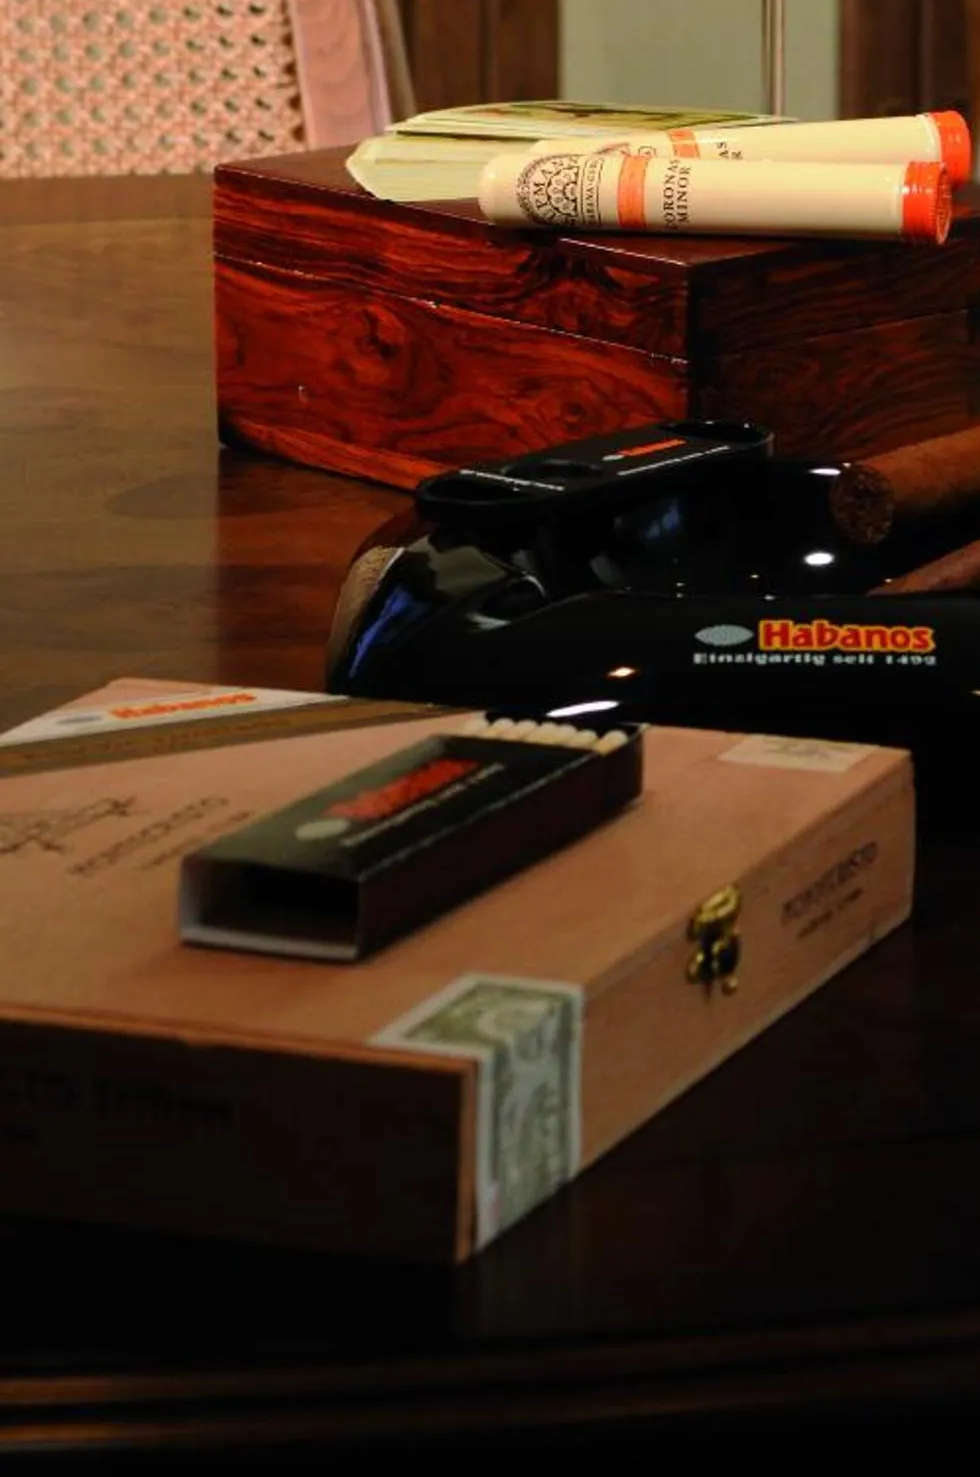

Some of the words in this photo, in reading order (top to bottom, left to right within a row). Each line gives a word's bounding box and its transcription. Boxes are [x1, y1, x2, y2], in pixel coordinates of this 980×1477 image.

[676, 167, 692, 224] MINOR
[758, 619, 936, 652] Habanos
[832, 653, 874, 665] seit
